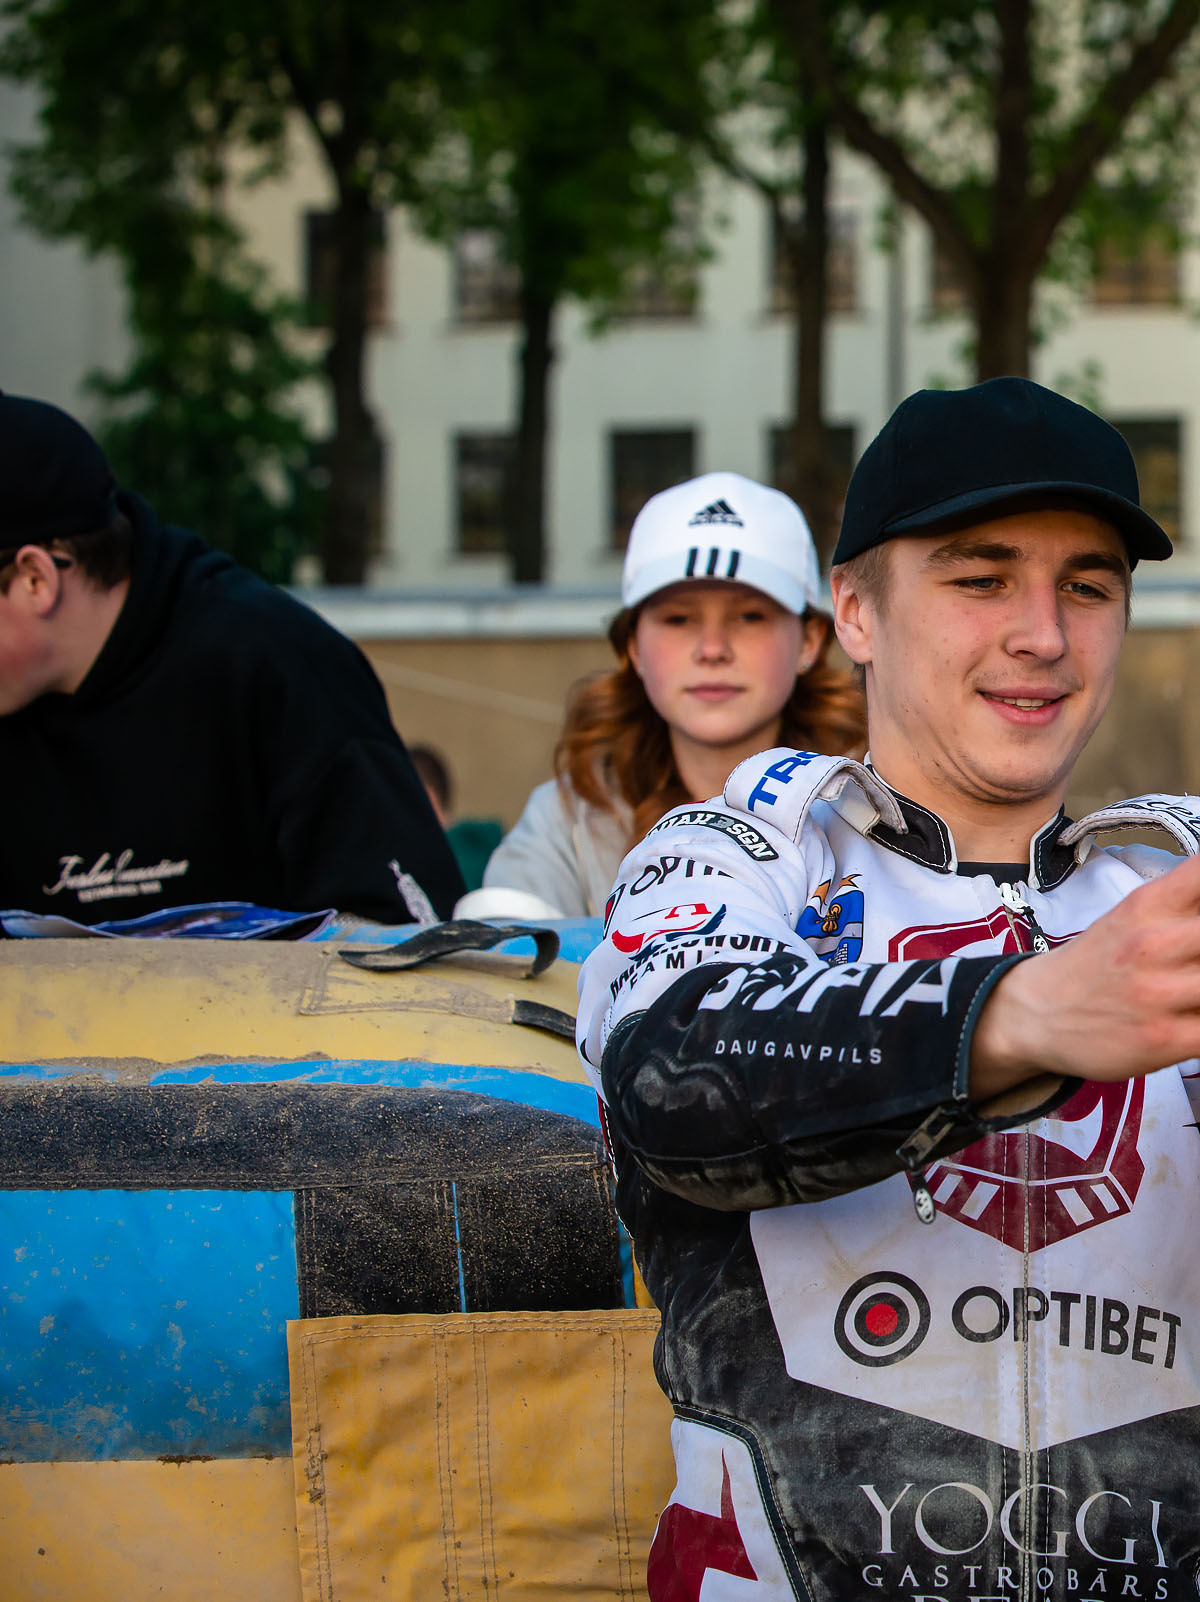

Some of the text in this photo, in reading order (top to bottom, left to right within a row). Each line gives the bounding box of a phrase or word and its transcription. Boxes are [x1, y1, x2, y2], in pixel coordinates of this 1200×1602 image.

[714, 1039, 882, 1064] DAUGAVPILS
[951, 1285, 1182, 1369] OPTIBET
[858, 1481, 1169, 1569] YOGGI
[861, 1564, 1168, 1600] GASTROBĀRS
